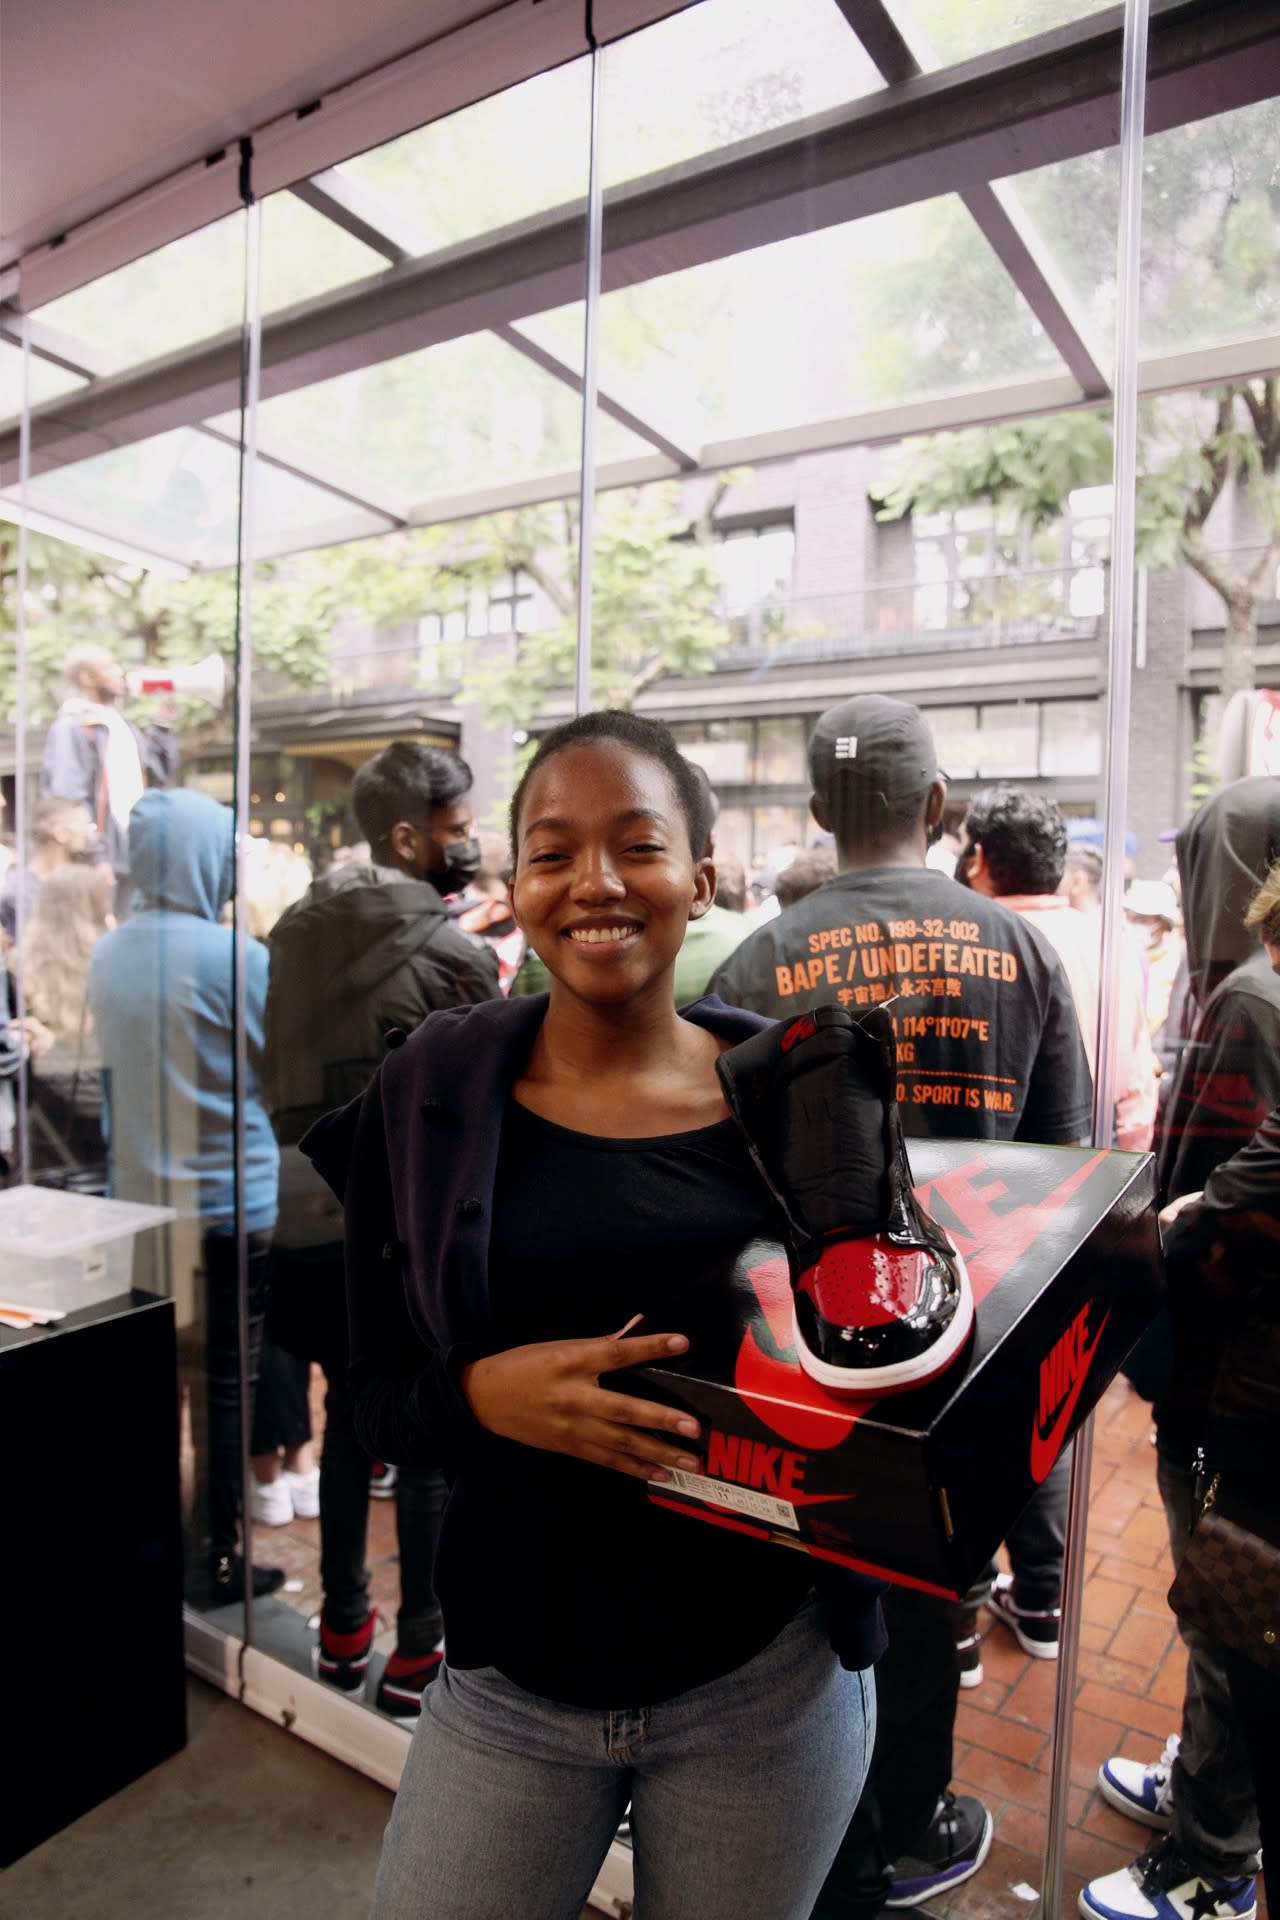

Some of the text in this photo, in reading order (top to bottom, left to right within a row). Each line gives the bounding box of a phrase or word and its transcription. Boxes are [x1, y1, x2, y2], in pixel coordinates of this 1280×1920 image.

[808, 927, 852, 953] SPEC
[855, 922, 885, 944] NO.
[775, 953, 842, 996] BAPE
[862, 942, 1018, 983] UNDEFEATED
[912, 1085, 961, 1105] SPORT
[965, 1088, 980, 1108] IS
[984, 1089, 1015, 1113] WAR.
[1040, 1299, 1090, 1430] NIKE
[707, 1430, 808, 1497] NIKE
